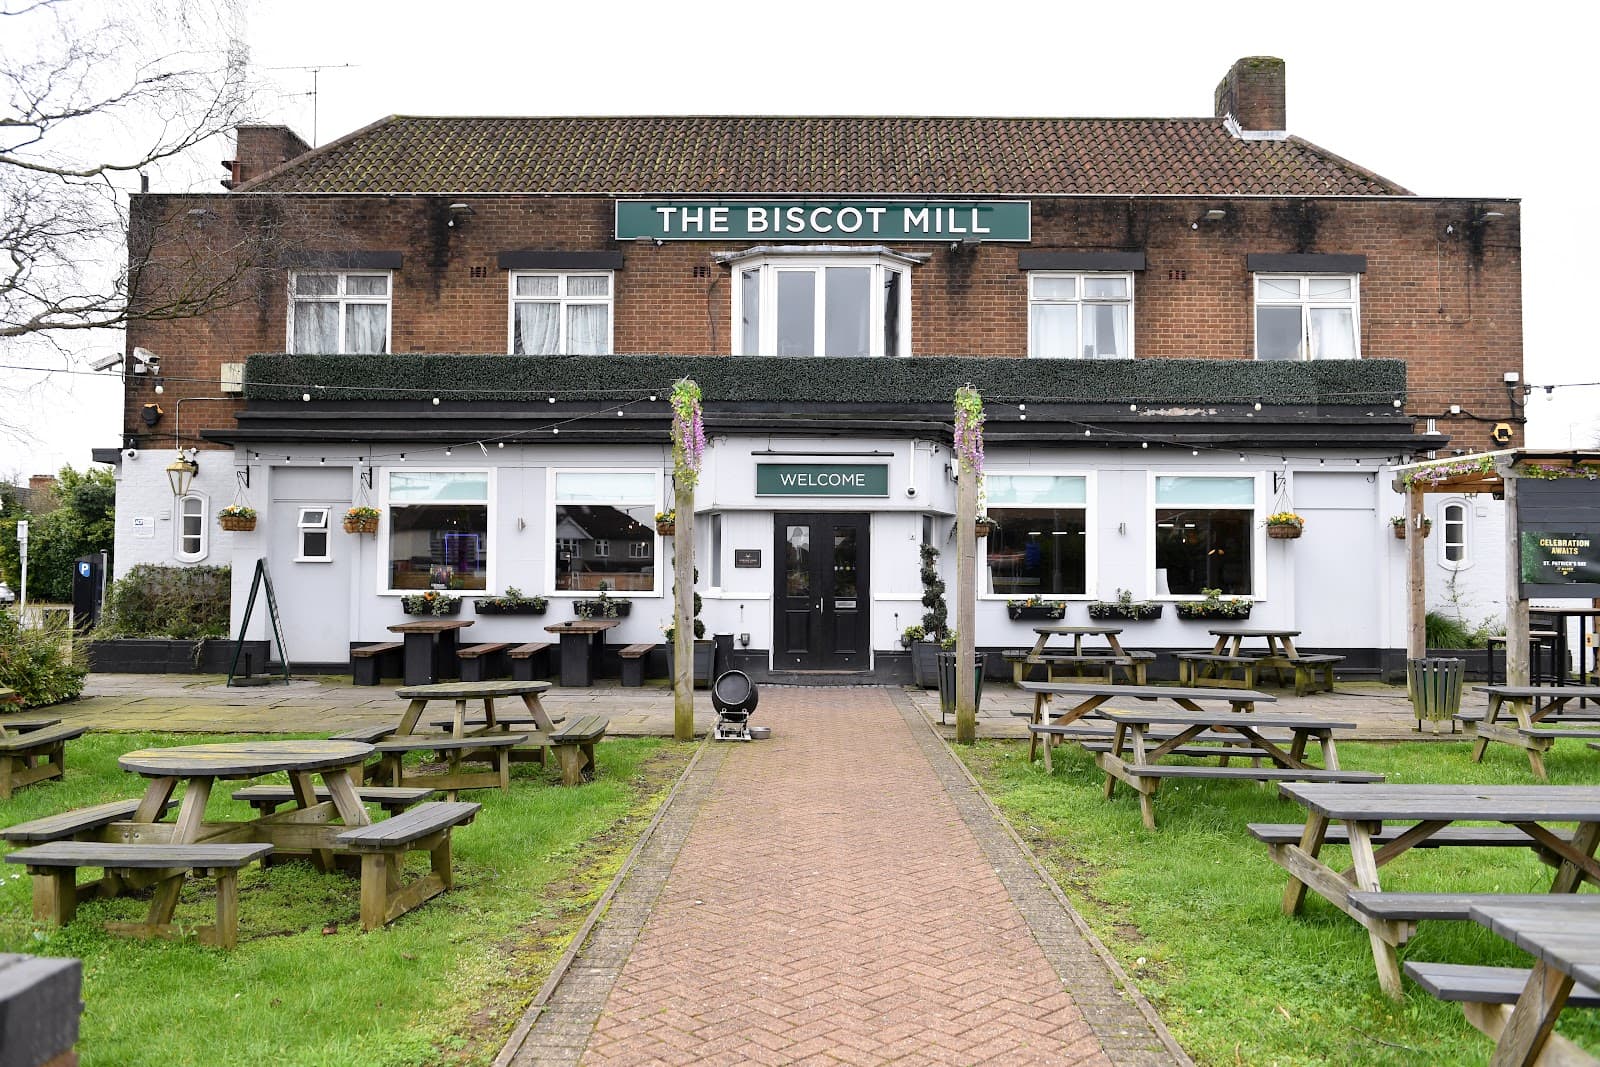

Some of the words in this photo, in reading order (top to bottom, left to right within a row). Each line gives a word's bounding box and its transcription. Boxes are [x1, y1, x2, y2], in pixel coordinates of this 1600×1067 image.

[656, 207, 729, 232] THE
[747, 206, 887, 233] BISCOT
[903, 207, 991, 233] MILL
[780, 473, 865, 486] WELCOME
[82, 563, 88, 574] P
